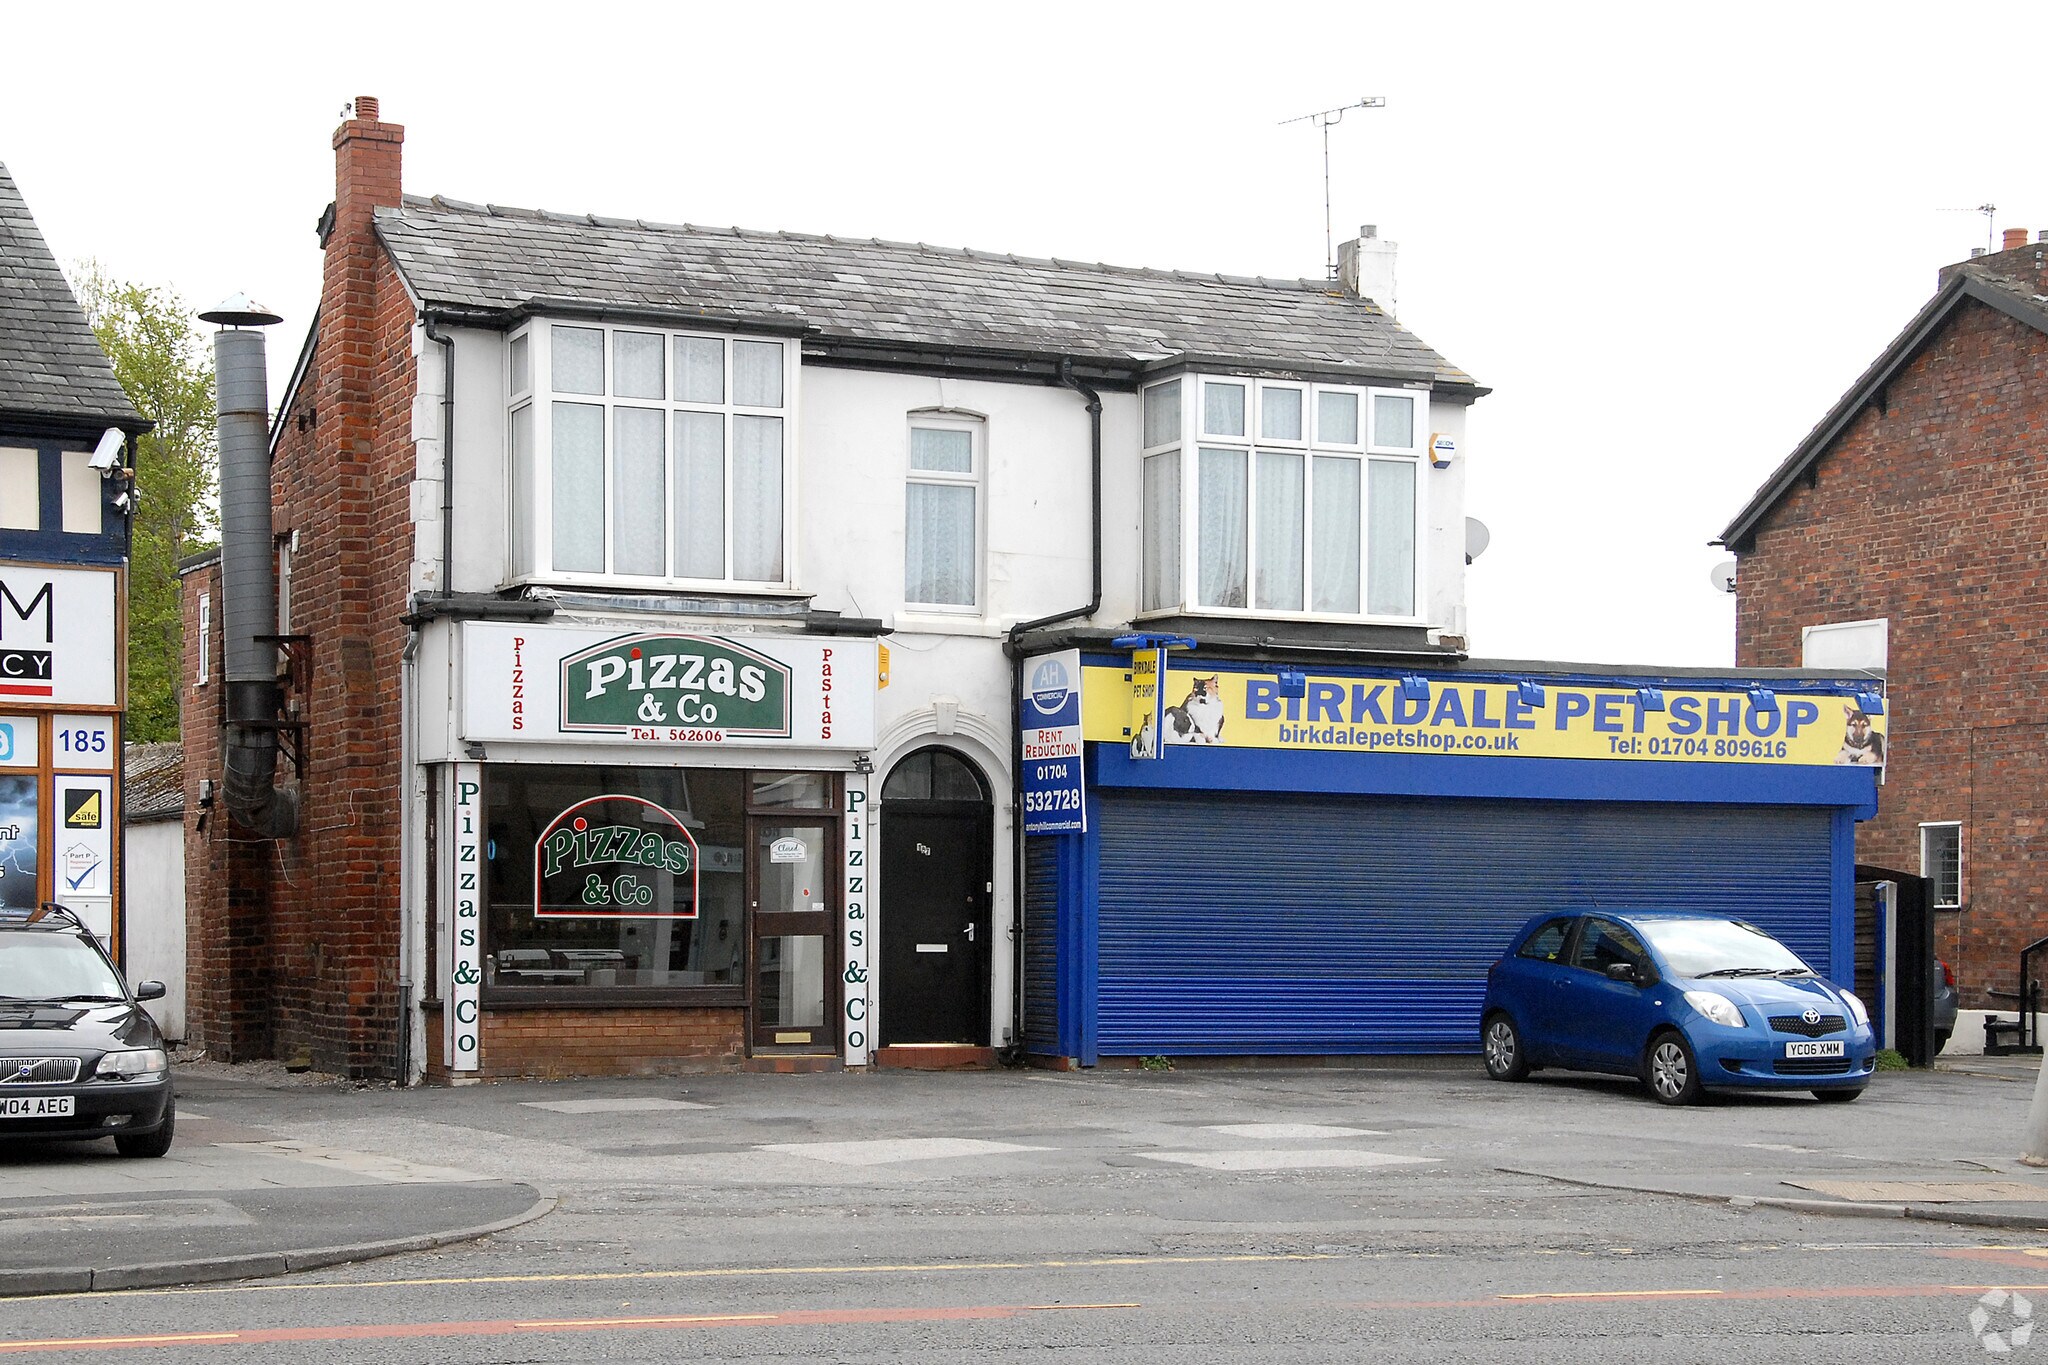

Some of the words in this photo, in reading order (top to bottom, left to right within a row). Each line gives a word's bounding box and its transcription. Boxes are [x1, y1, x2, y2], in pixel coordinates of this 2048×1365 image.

[585, 647, 767, 702] Pizzas
[1040, 664, 1059, 686] AH
[1133, 661, 1156, 674] BIRKDALE
[513, 637, 525, 730] Pizzas
[822, 648, 833, 739] Pastas
[637, 693, 667, 722] &
[676, 693, 718, 724] Co
[1245, 679, 1536, 730] BIRKDALE
[1554, 692, 1647, 733] PET
[1667, 697, 1820, 738] SHOP
[59, 729, 106, 752] 185
[631, 727, 660, 741] Tel.
[669, 730, 722, 742] 562606
[1278, 724, 1520, 752] birkdalepetshop.co.uk
[1608, 735, 1642, 754] Tel:
[1648, 737, 1709, 756] 01704
[1713, 739, 1788, 758] 809616
[1037, 764, 1067, 780] 01704
[1026, 788, 1080, 812] 532728
[75, 811, 97, 821] safe
[544, 817, 690, 878] Pizzas
[458, 782, 479, 947] Pizzas
[846, 790, 866, 947] Pizzas
[582, 873, 611, 906] &
[613, 873, 653, 906] Co
[1790, 1044, 1817, 1055] YC06
[1819, 1043, 1840, 1055] XMM
[37, 1099, 69, 1113] AEG
